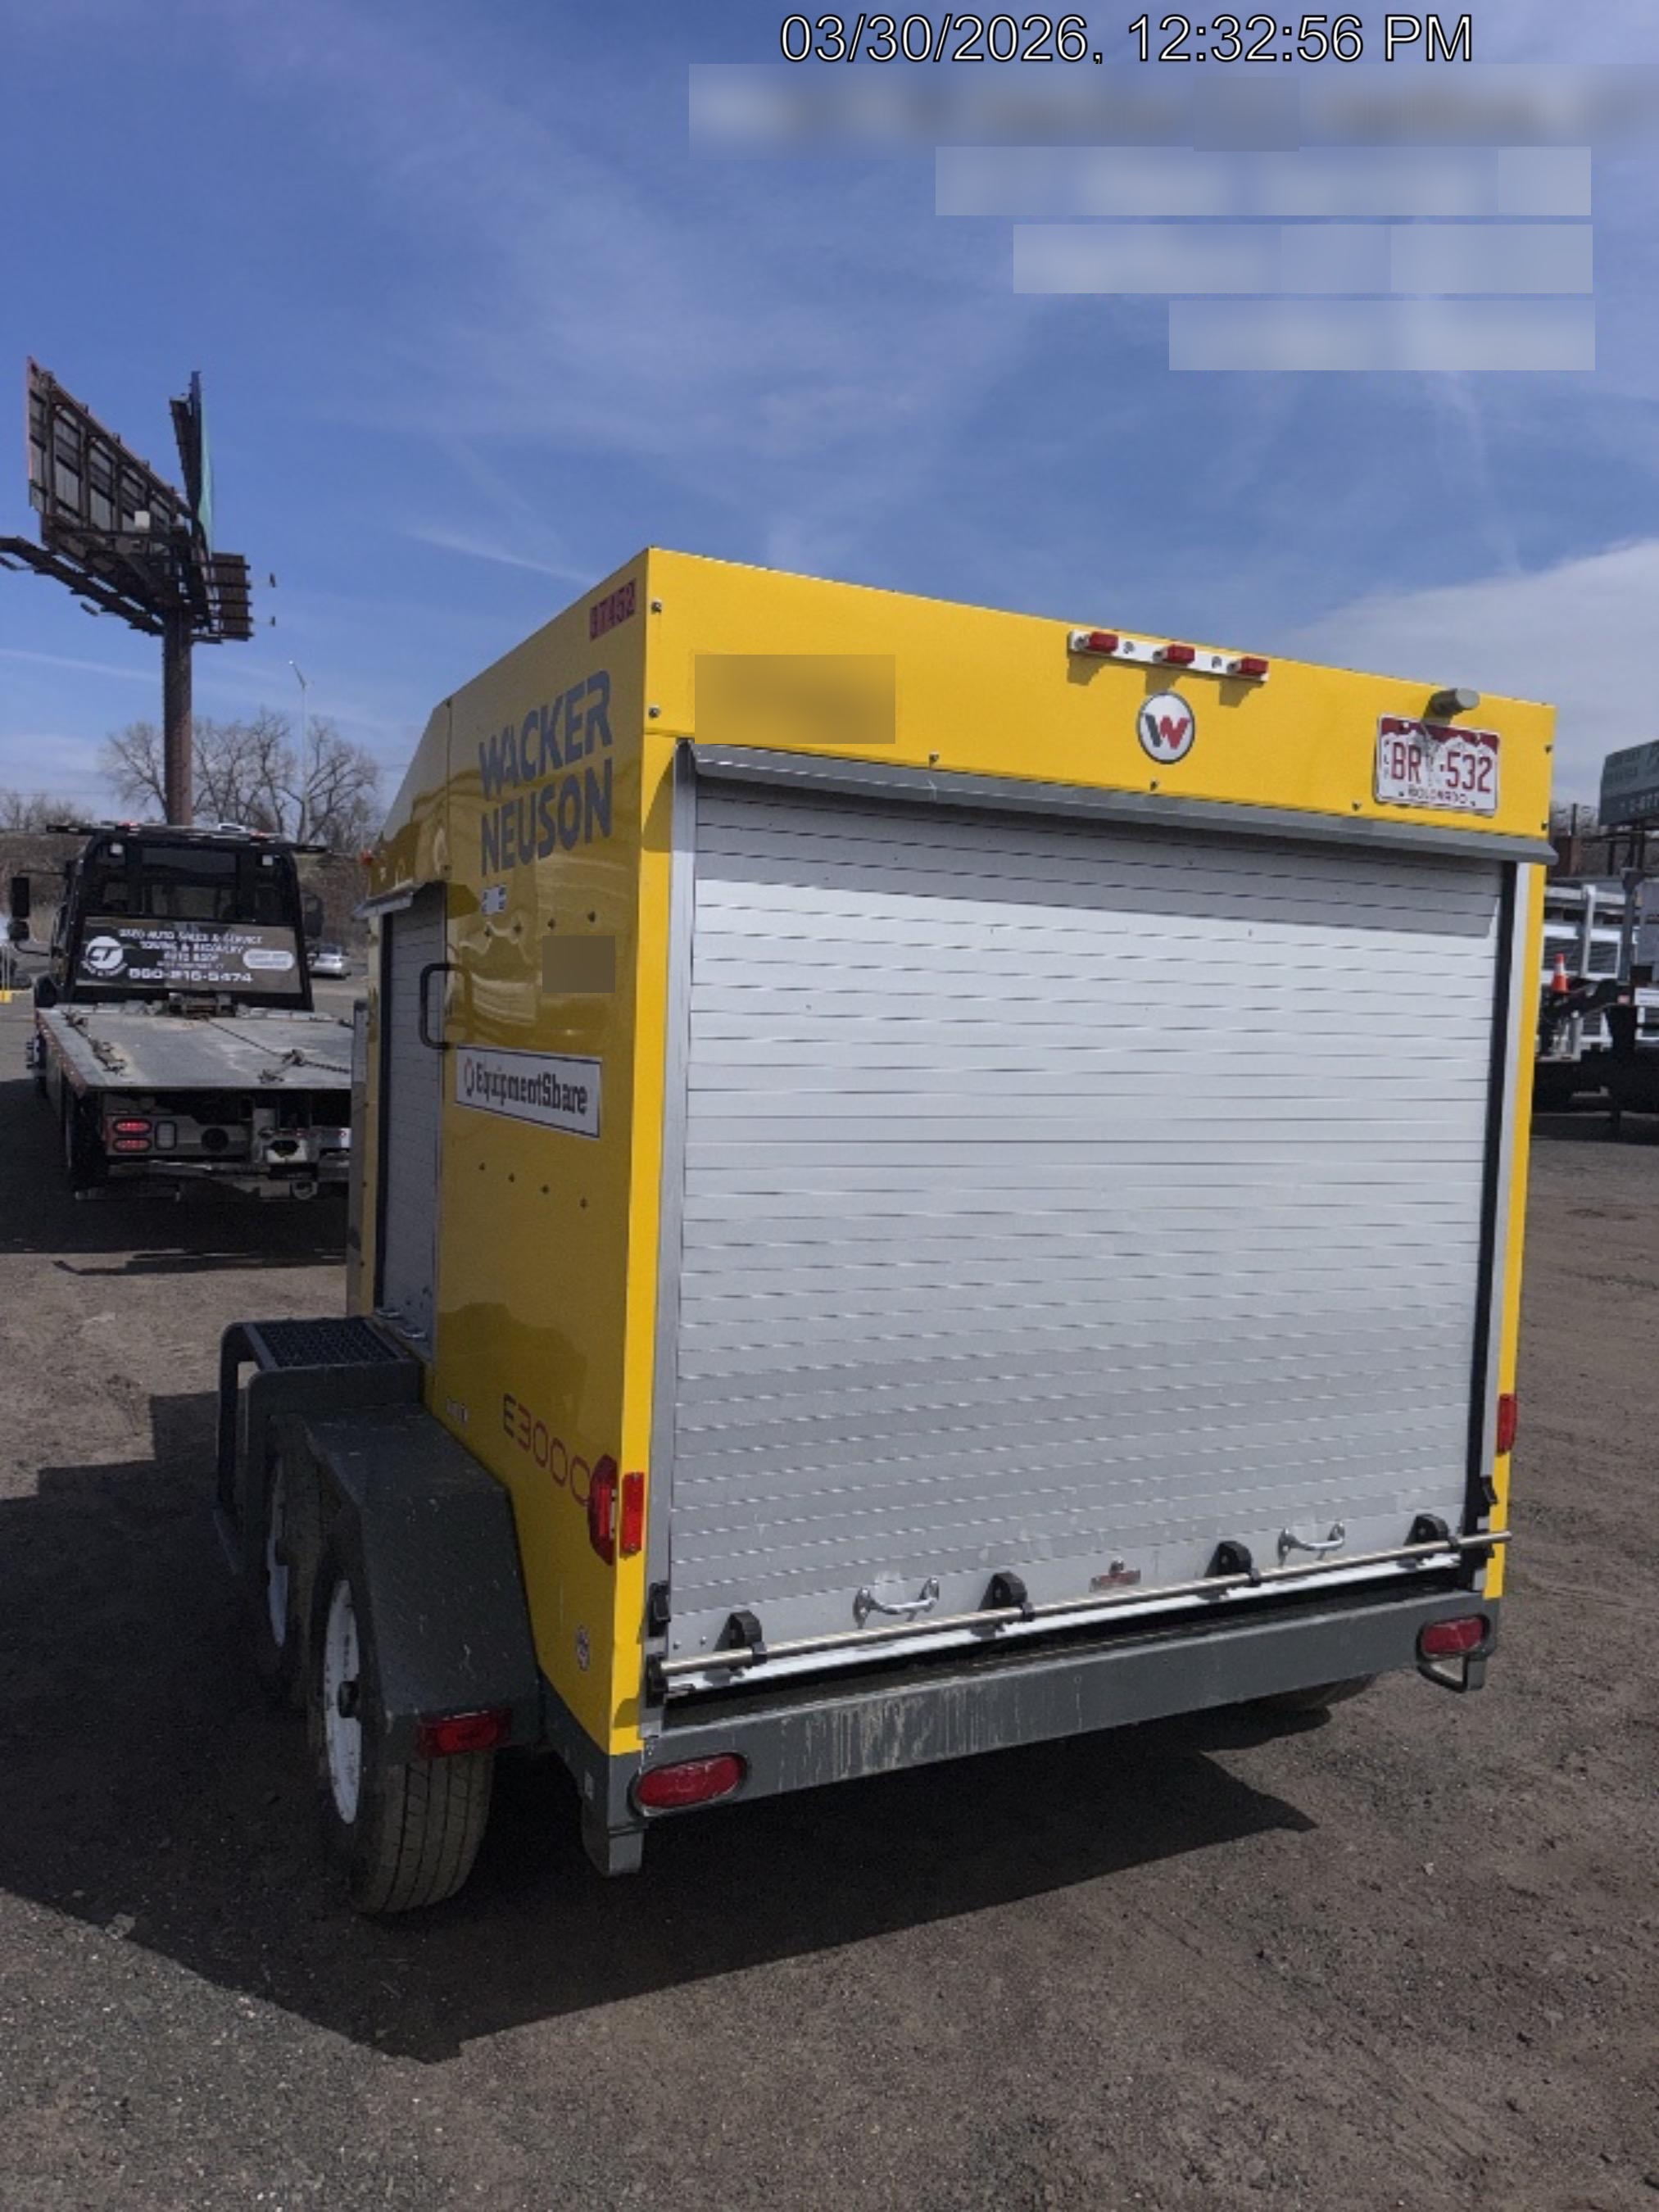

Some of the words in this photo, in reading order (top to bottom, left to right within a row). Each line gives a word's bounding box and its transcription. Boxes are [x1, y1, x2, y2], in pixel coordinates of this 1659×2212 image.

[478, 670, 612, 801] WACKER
[481, 757, 612, 877] NEUSON
[475, 1062, 588, 1115] EquipmentShare
[503, 1393, 591, 1507] E3000
